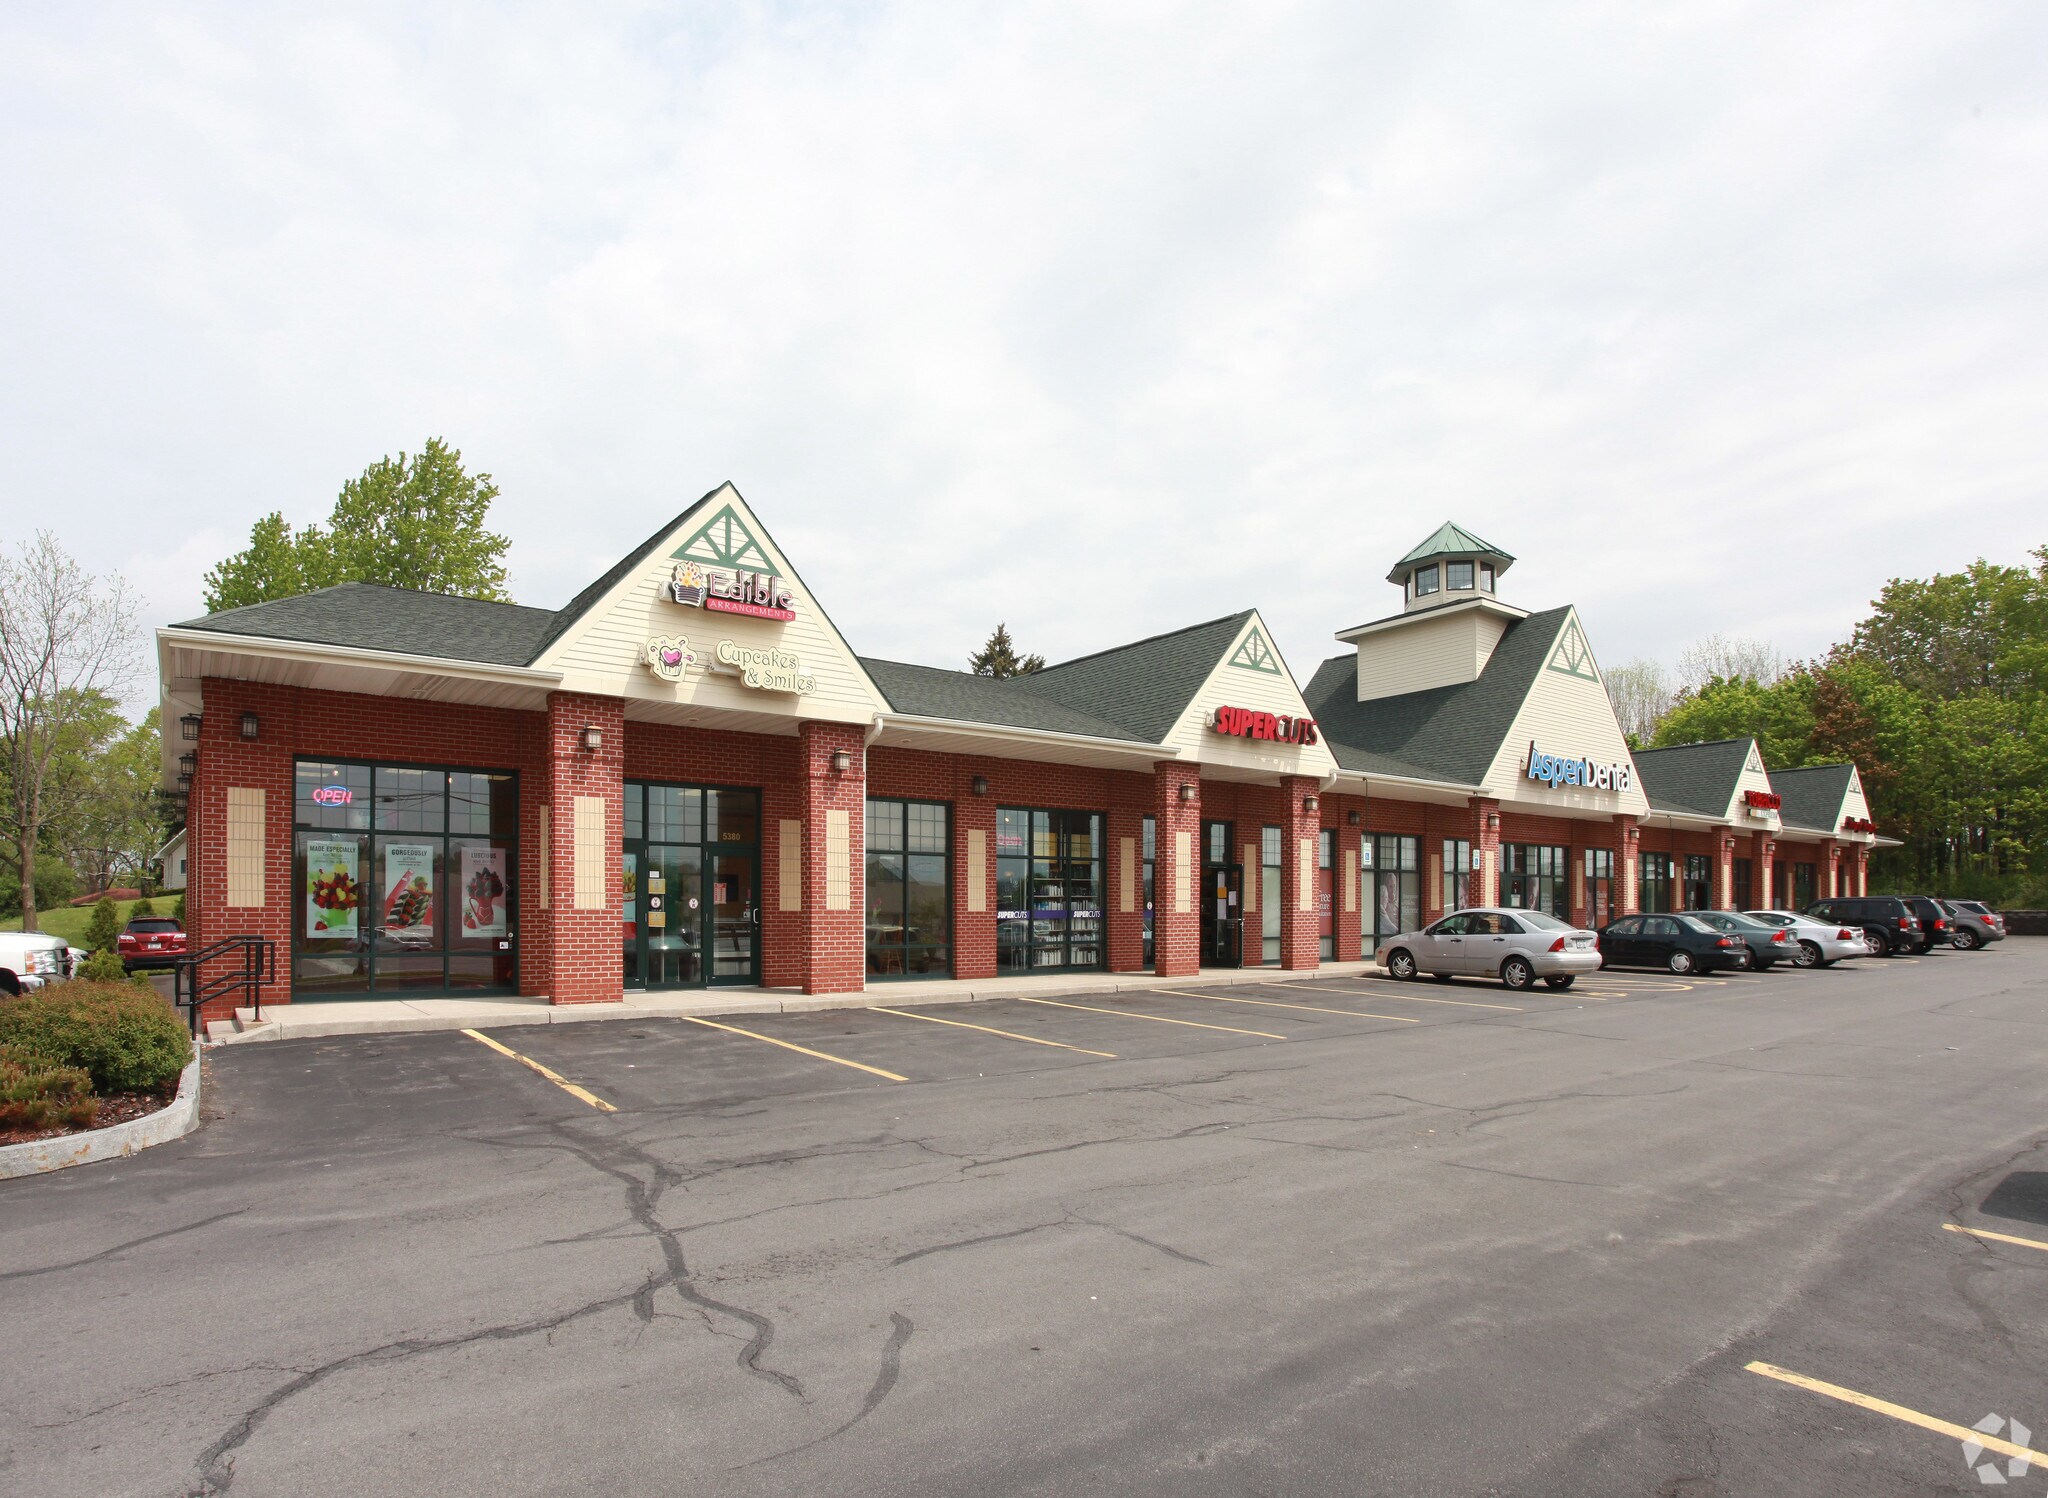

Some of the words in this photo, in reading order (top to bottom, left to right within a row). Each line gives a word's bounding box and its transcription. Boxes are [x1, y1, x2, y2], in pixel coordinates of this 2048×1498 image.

[708, 569, 794, 609] Edible
[709, 599, 793, 620] ARRANGEMENTS
[720, 642, 796, 670] Cupcakes
[747, 669, 759, 684] &
[764, 671, 815, 694] Smiles
[1216, 705, 1318, 746] SUPERCUTS
[313, 788, 352, 804] OPEN
[722, 832, 741, 841] 5380
[997, 911, 1028, 919] SUPERCUTS
[1073, 910, 1101, 918] SUPERCUTS
